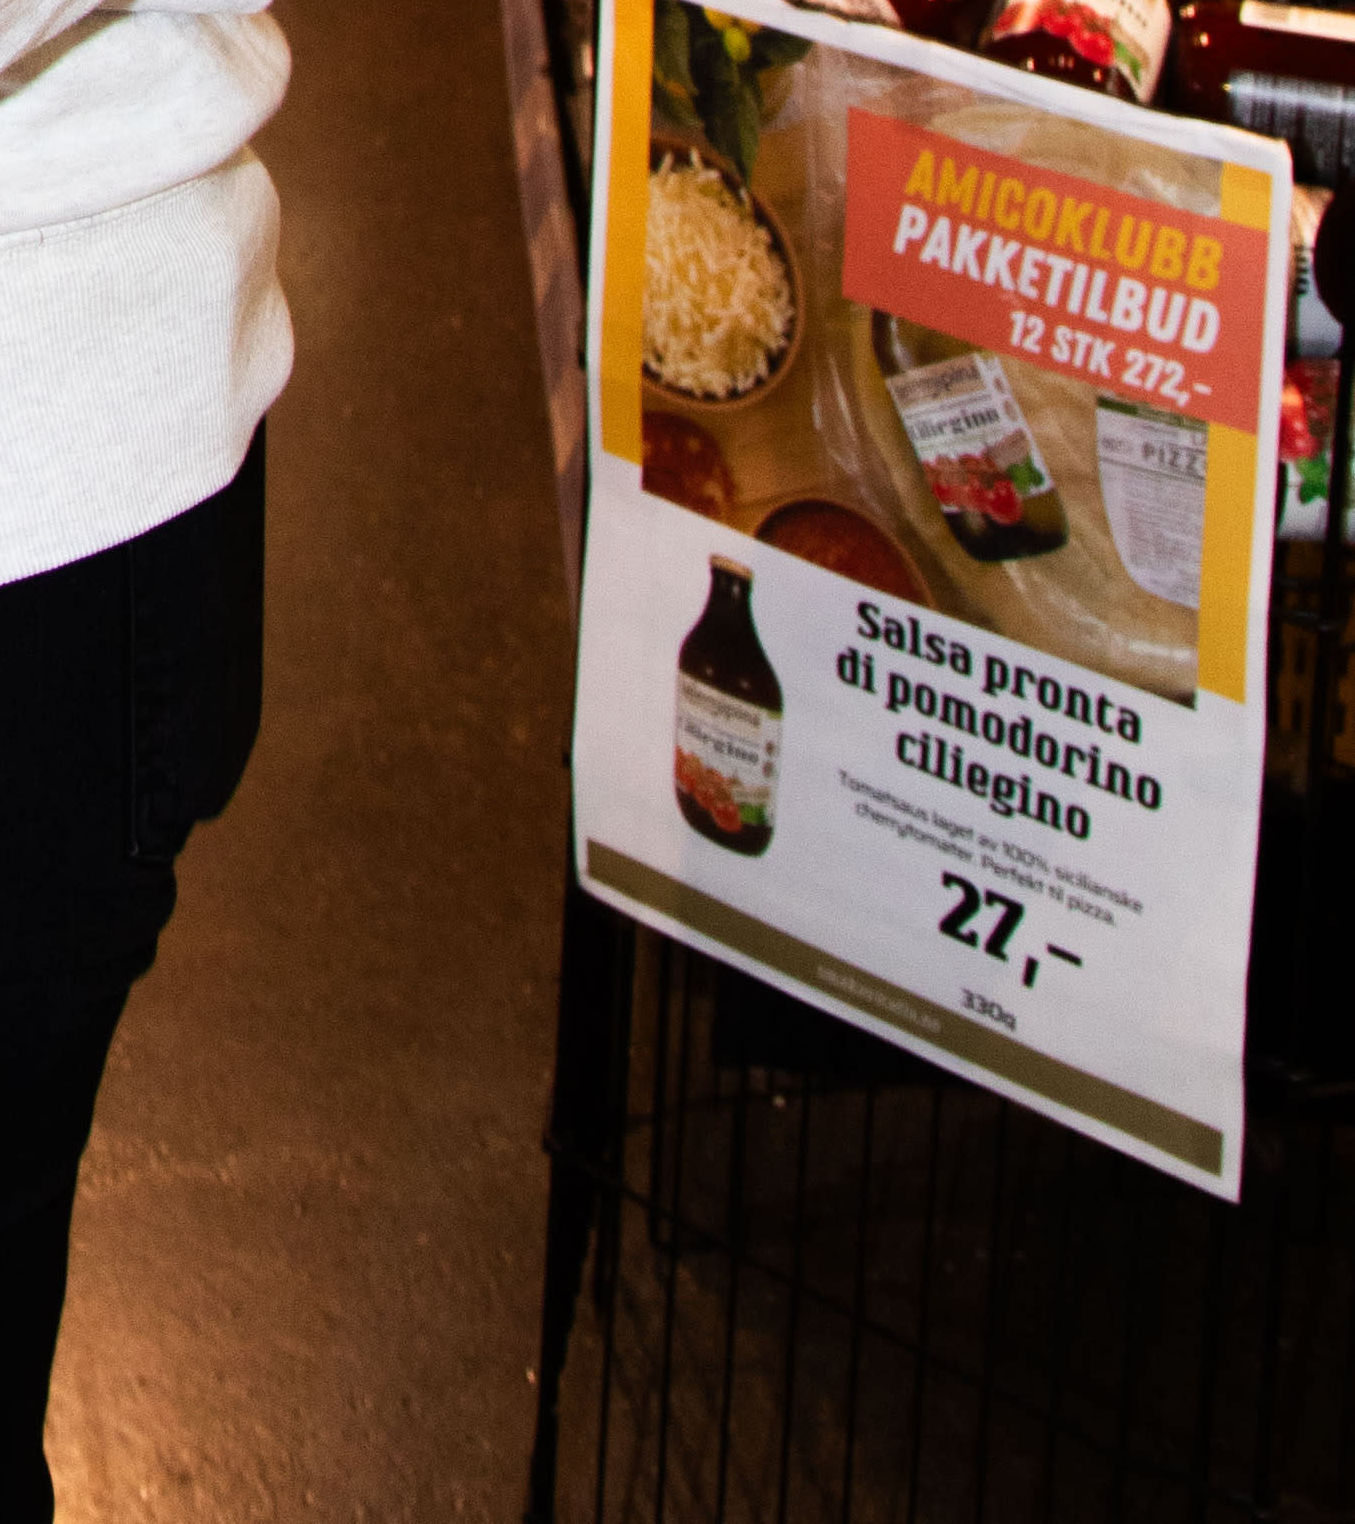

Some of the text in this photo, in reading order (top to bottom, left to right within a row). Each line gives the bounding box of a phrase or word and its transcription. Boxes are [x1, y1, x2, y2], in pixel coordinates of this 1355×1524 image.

[892, 203, 1222, 354] PAKKETILBUD
[904, 149, 1224, 291] AMICOKLUBB
[1009, 310, 1214, 408] 12 STK 272,-
[836, 645, 1163, 812] di pomodorino
[856, 599, 1142, 746] Salsa pronta
[895, 730, 1091, 842] ciliegino
